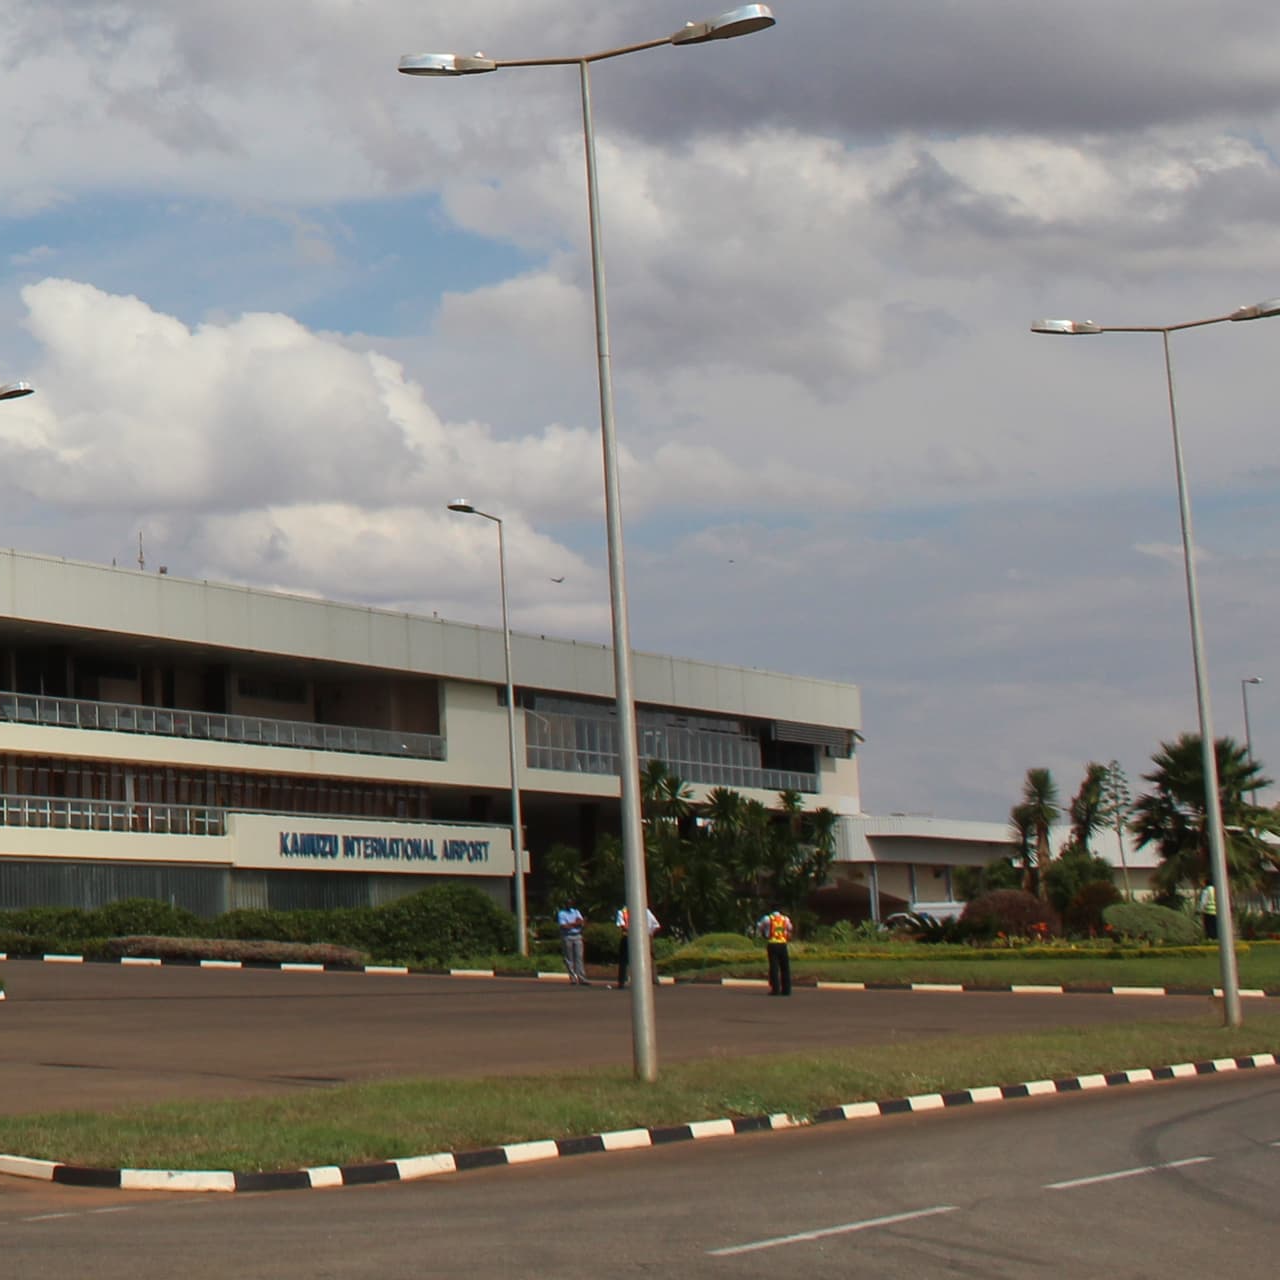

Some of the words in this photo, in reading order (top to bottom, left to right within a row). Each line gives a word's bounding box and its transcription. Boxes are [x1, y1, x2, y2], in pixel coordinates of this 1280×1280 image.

[280, 831, 338, 858] KAMUZU
[342, 835, 438, 861] INTERNATIONAL
[441, 839, 490, 862] AIRPORT
